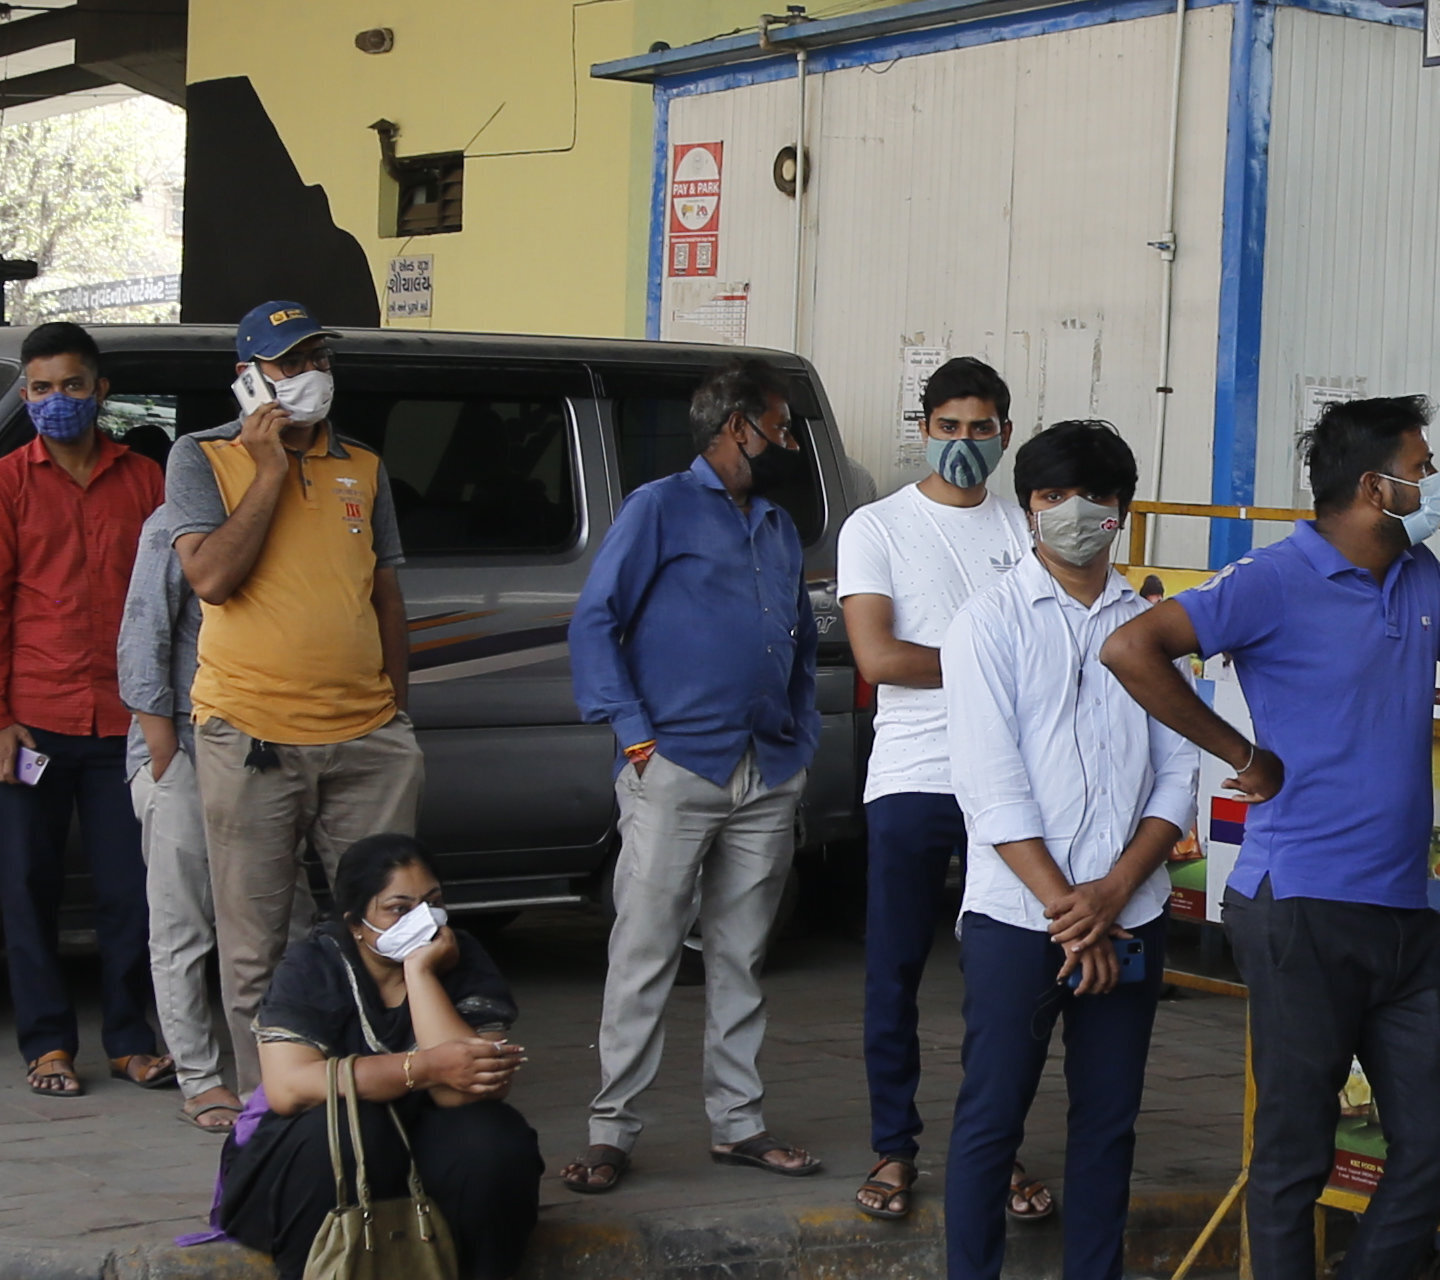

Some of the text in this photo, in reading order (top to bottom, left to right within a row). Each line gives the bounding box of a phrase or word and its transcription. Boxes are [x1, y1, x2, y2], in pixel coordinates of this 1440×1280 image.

[673, 182, 719, 195] PAY & PARK
